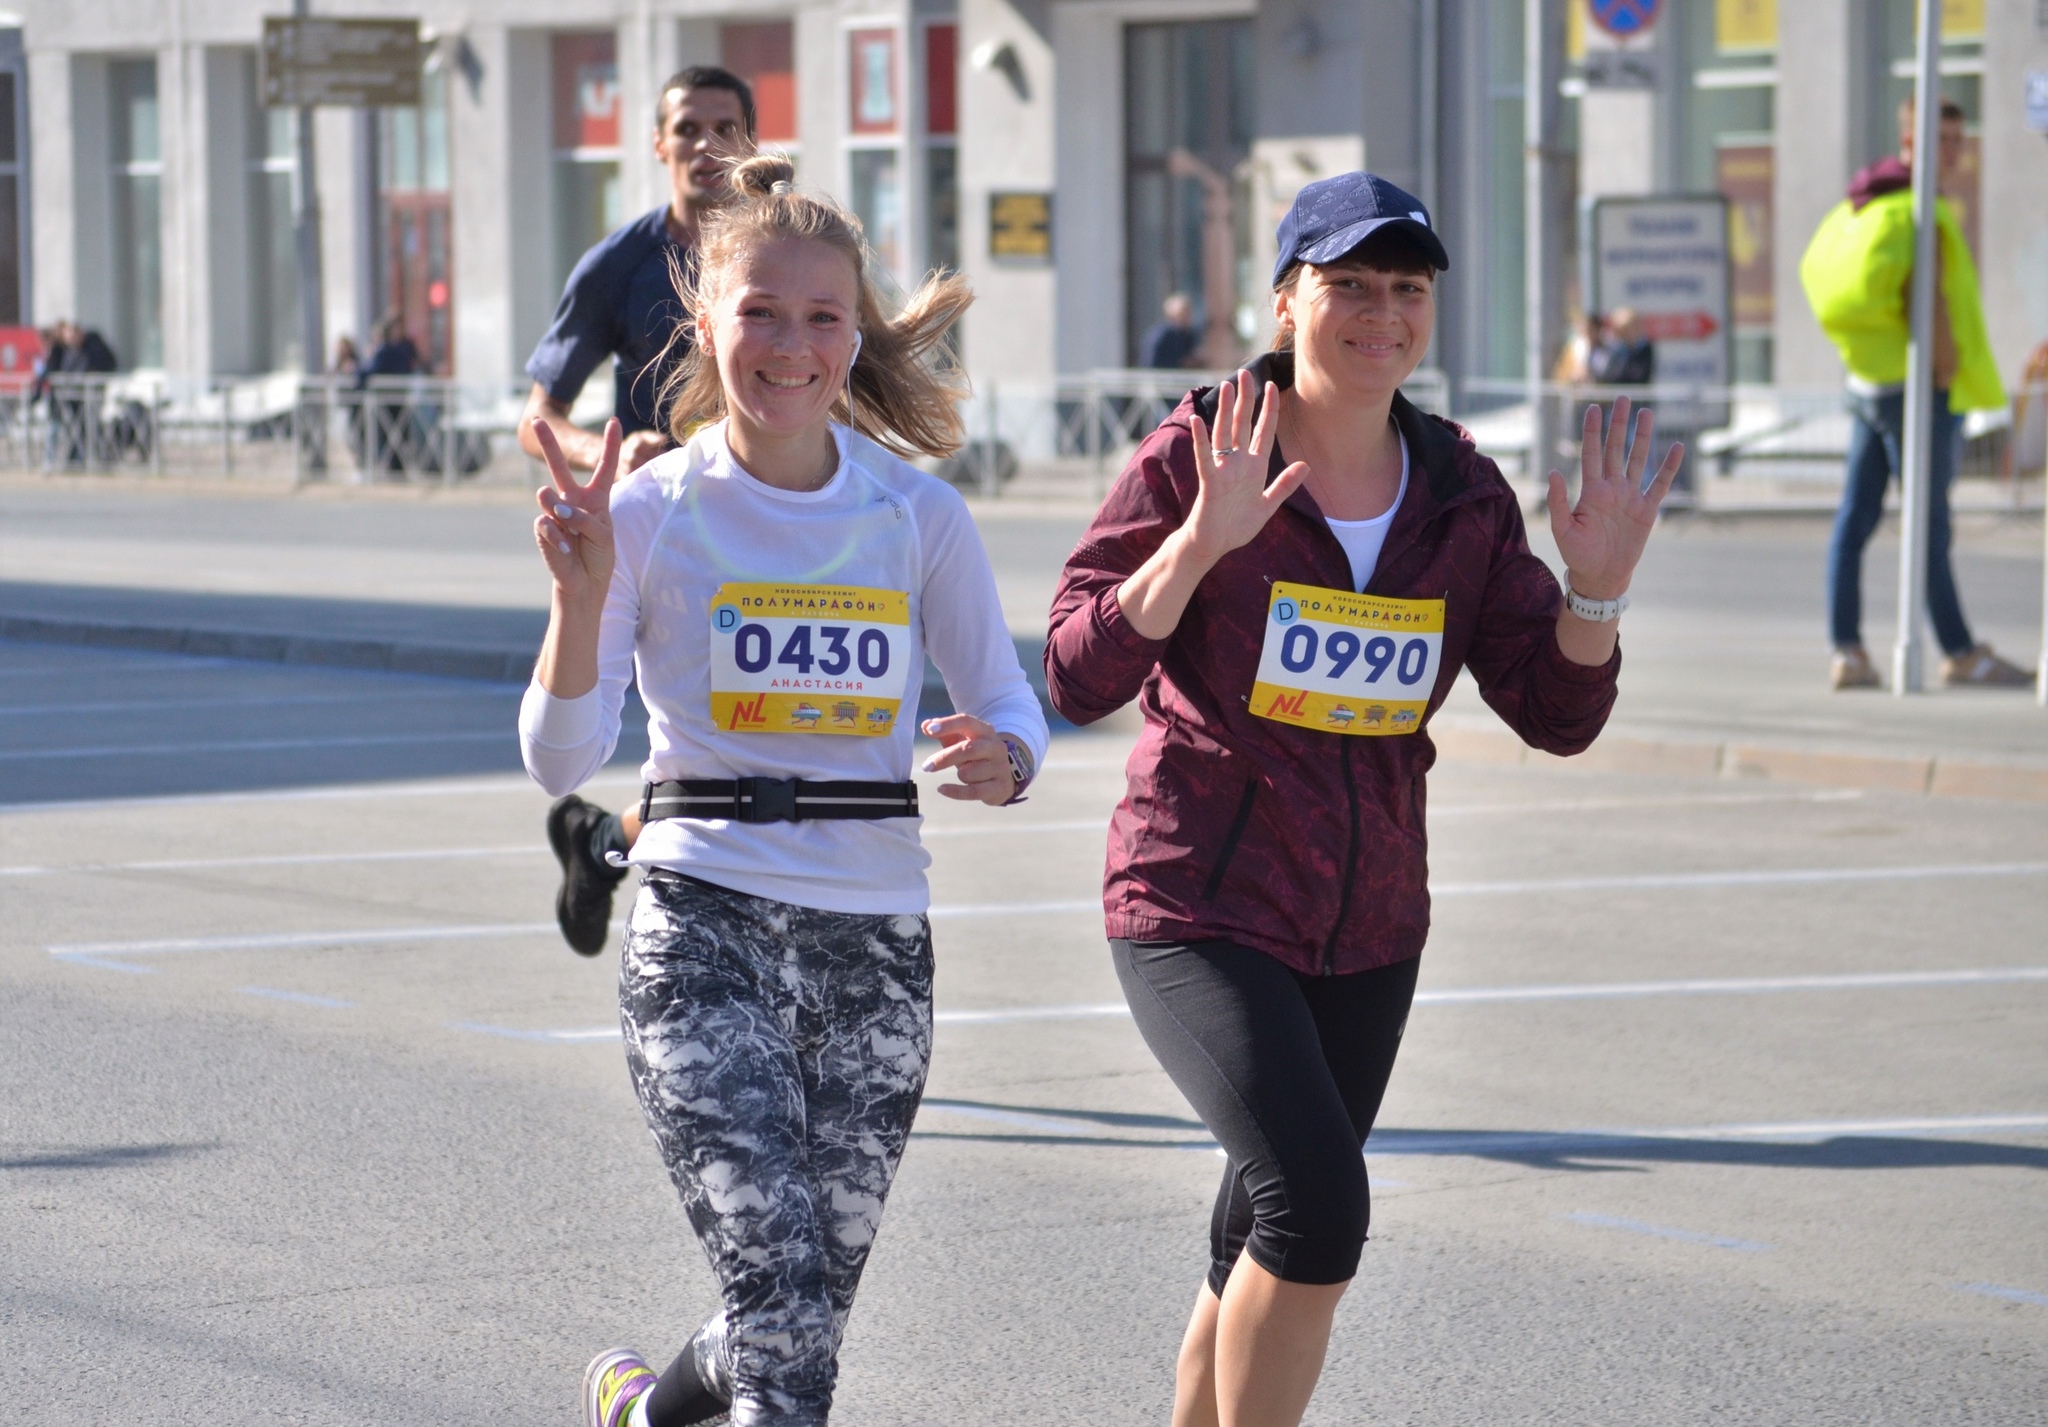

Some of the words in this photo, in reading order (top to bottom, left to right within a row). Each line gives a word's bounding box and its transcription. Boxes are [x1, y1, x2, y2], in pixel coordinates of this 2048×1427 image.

[775, 588, 831, 596] НОВОСИБИРСК
[1333, 595, 1385, 608] НОВОСИБИРСК
[742, 597, 875, 611] ПОЛУМАРАФОН
[1278, 602, 1294, 621] D
[1301, 600, 1421, 622] ПОЛУМАРАФОН
[720, 609, 735, 628] D
[735, 623, 889, 678] 0430
[1280, 624, 1429, 686] 0990
[771, 678, 863, 690] АНАСТАСИЯ
[729, 692, 767, 730] NL
[1266, 690, 1309, 717] NL
